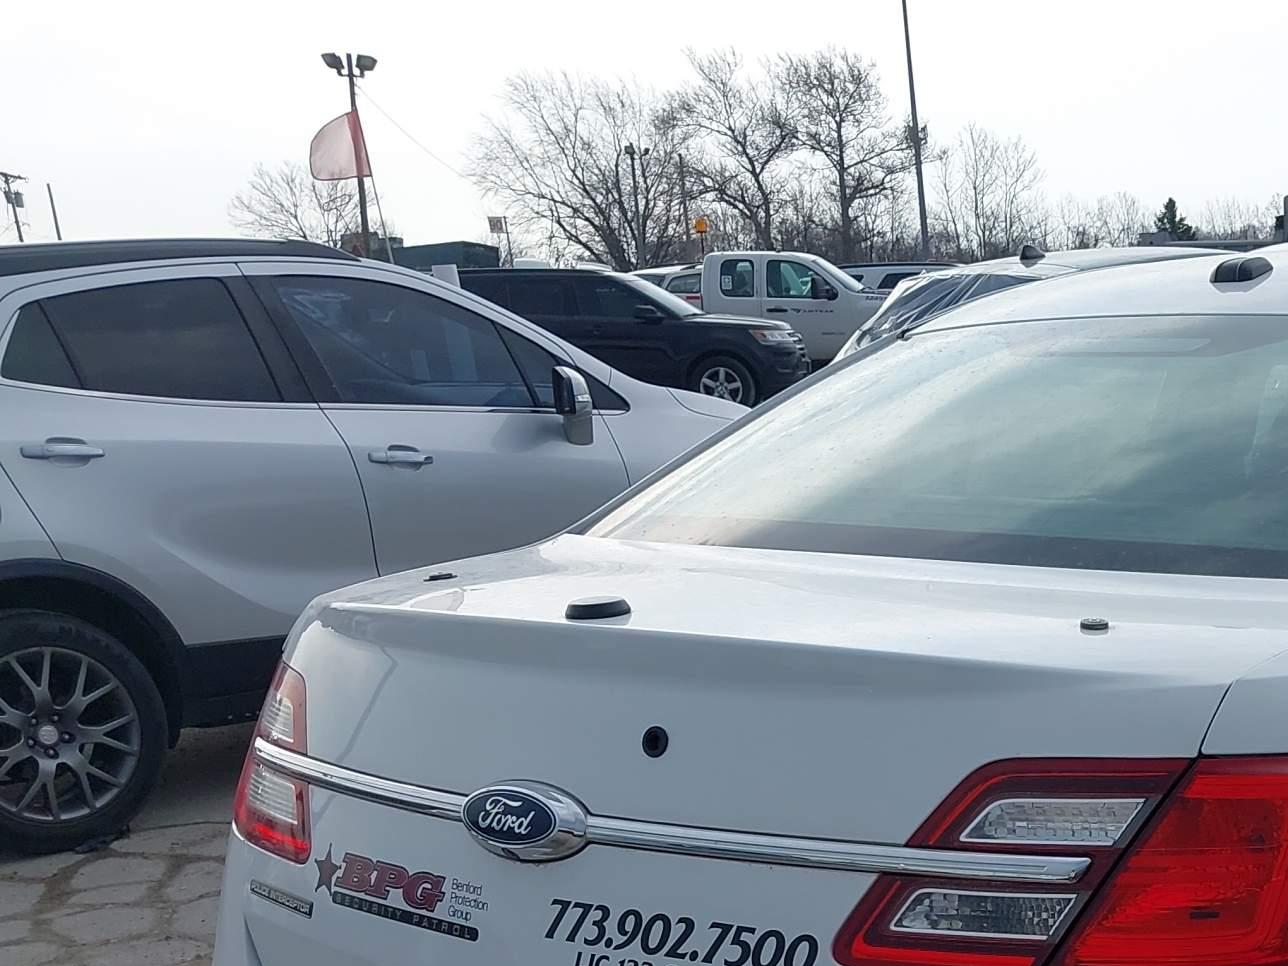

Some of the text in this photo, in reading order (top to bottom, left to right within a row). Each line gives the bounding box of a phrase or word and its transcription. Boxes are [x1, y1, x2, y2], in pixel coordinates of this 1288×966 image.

[479, 796, 535, 835] Ford
[335, 852, 446, 912] BPG
[451, 878, 483, 896] Benford
[335, 893, 472, 939] SECURITY PATROL
[447, 907, 473, 922] Group
[450, 893, 489, 911] Protection
